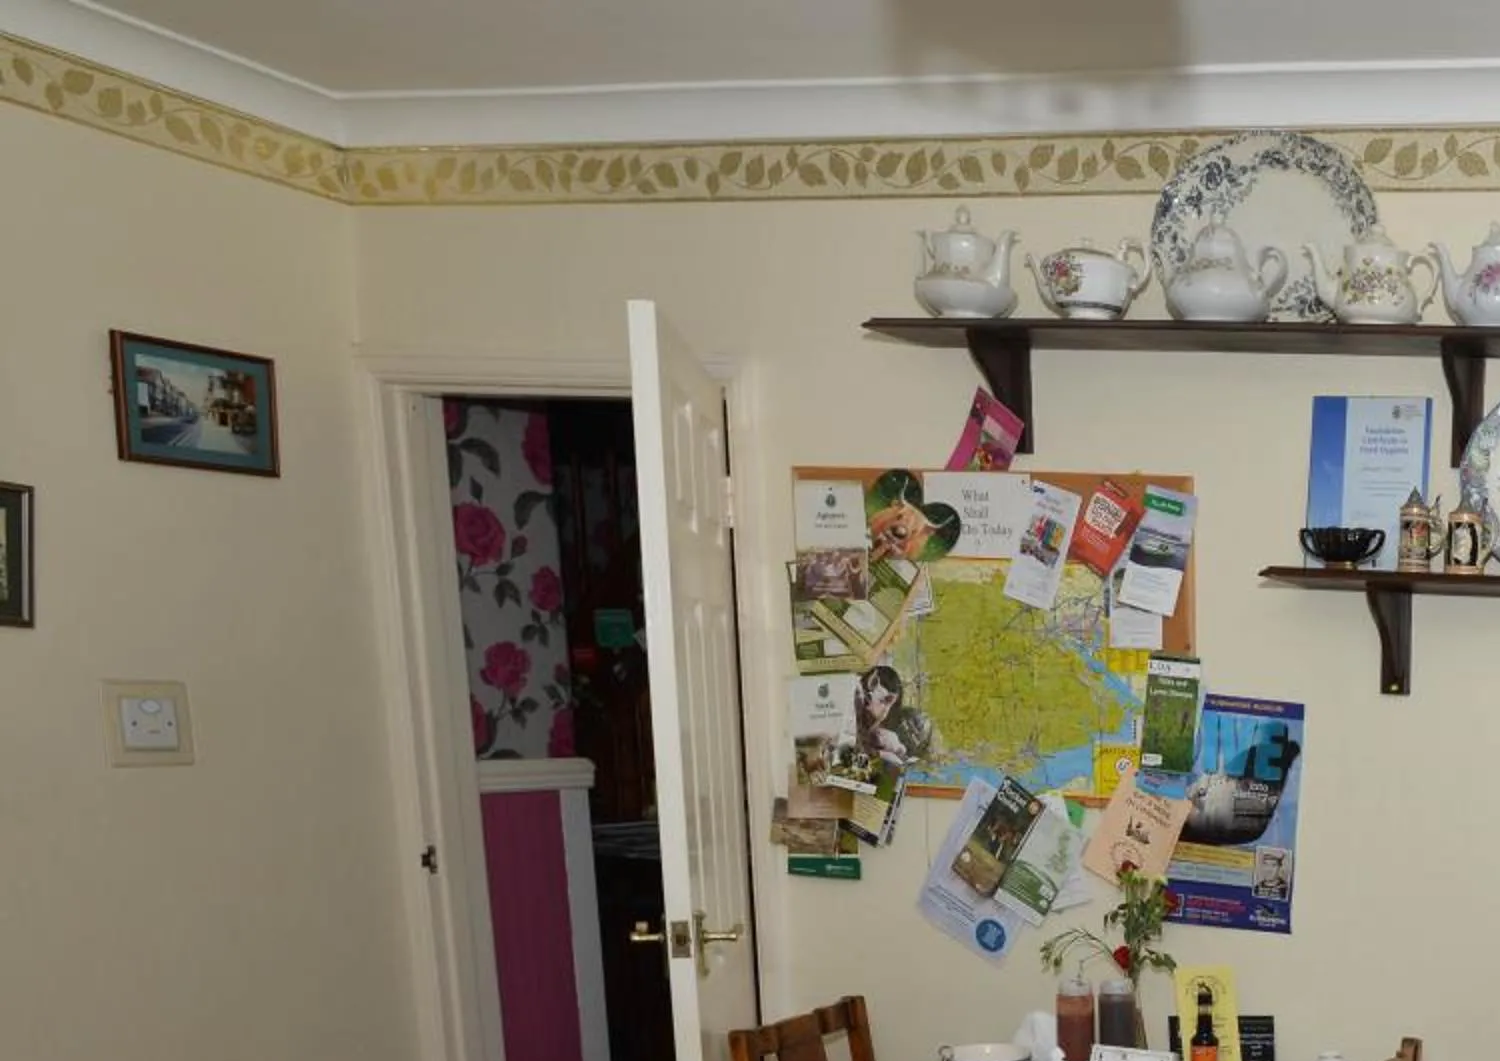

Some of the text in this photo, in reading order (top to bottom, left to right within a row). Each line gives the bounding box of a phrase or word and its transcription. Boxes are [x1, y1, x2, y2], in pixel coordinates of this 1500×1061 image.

[962, 489, 989, 501] What
[963, 506, 989, 518] Shall
[981, 523, 1013, 539] Today
[1203, 711, 1285, 780] IVE
